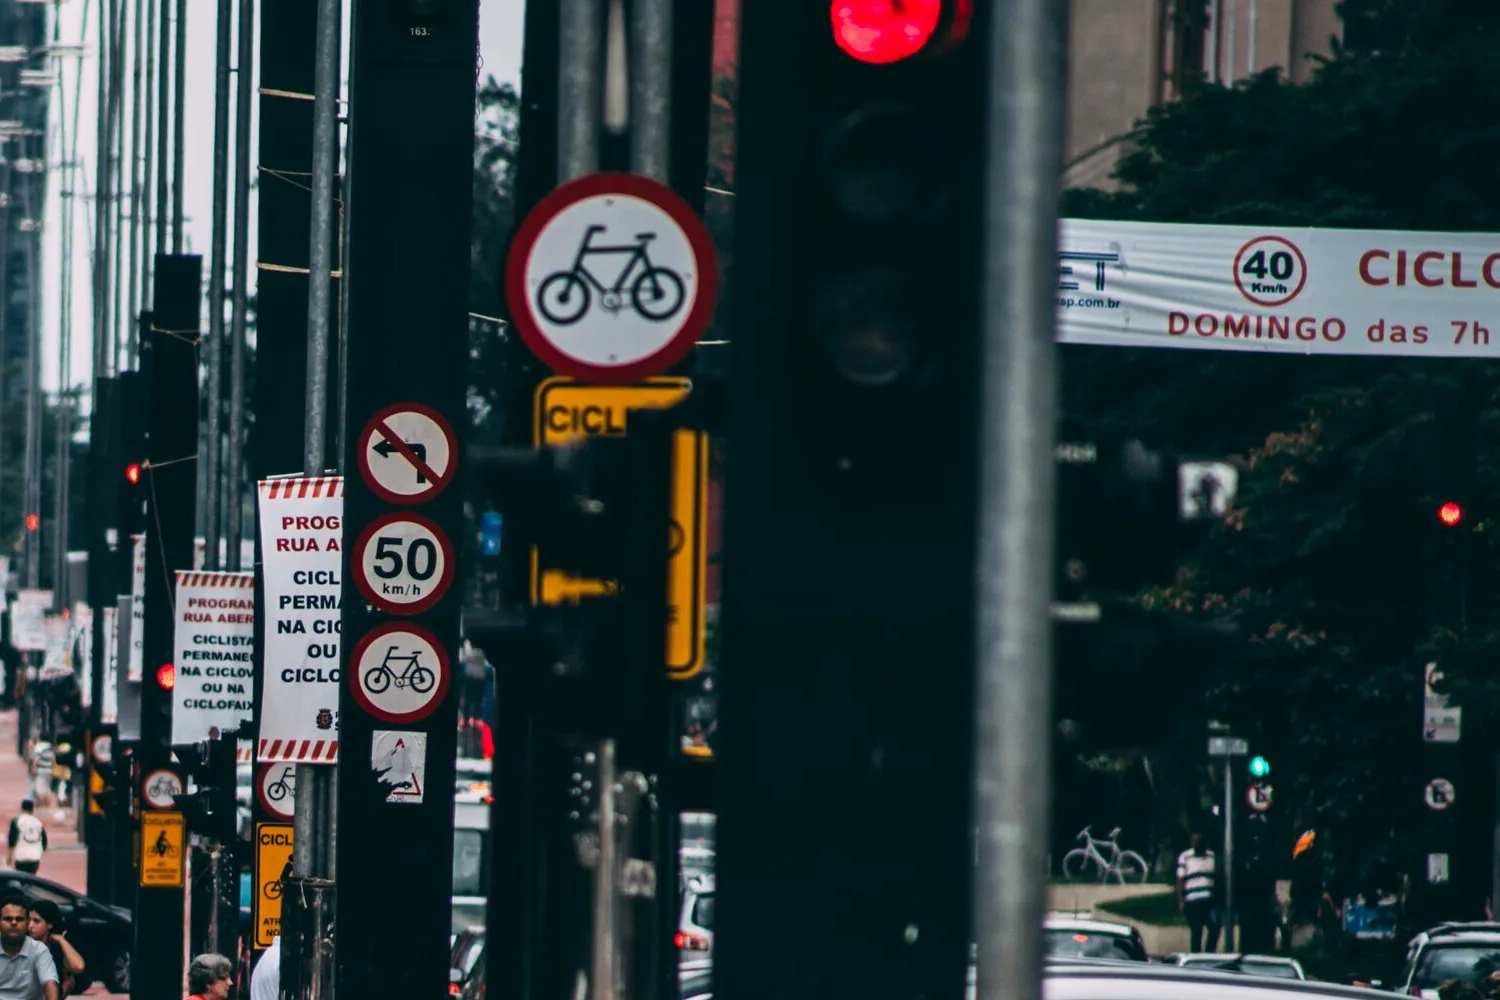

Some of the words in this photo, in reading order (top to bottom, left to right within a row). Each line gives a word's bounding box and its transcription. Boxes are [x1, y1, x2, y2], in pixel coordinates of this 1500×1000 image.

[1242, 250, 1294, 280] 40
[1251, 282, 1288, 294] Km/h
[1168, 311, 1347, 342] DOMINGO
[1367, 318, 1429, 344] das
[1451, 320, 1490, 345] 7h
[276, 538, 319, 552] RUA
[373, 536, 437, 581] 50
[293, 571, 341, 585] CICL
[382, 583, 421, 596] km/h
[183, 612, 213, 623] RUA
[277, 620, 306, 634] NA
[307, 644, 337, 658] OU
[181, 667, 201, 676] NA
[202, 683, 222, 693] OU
[227, 684, 245, 693] NA
